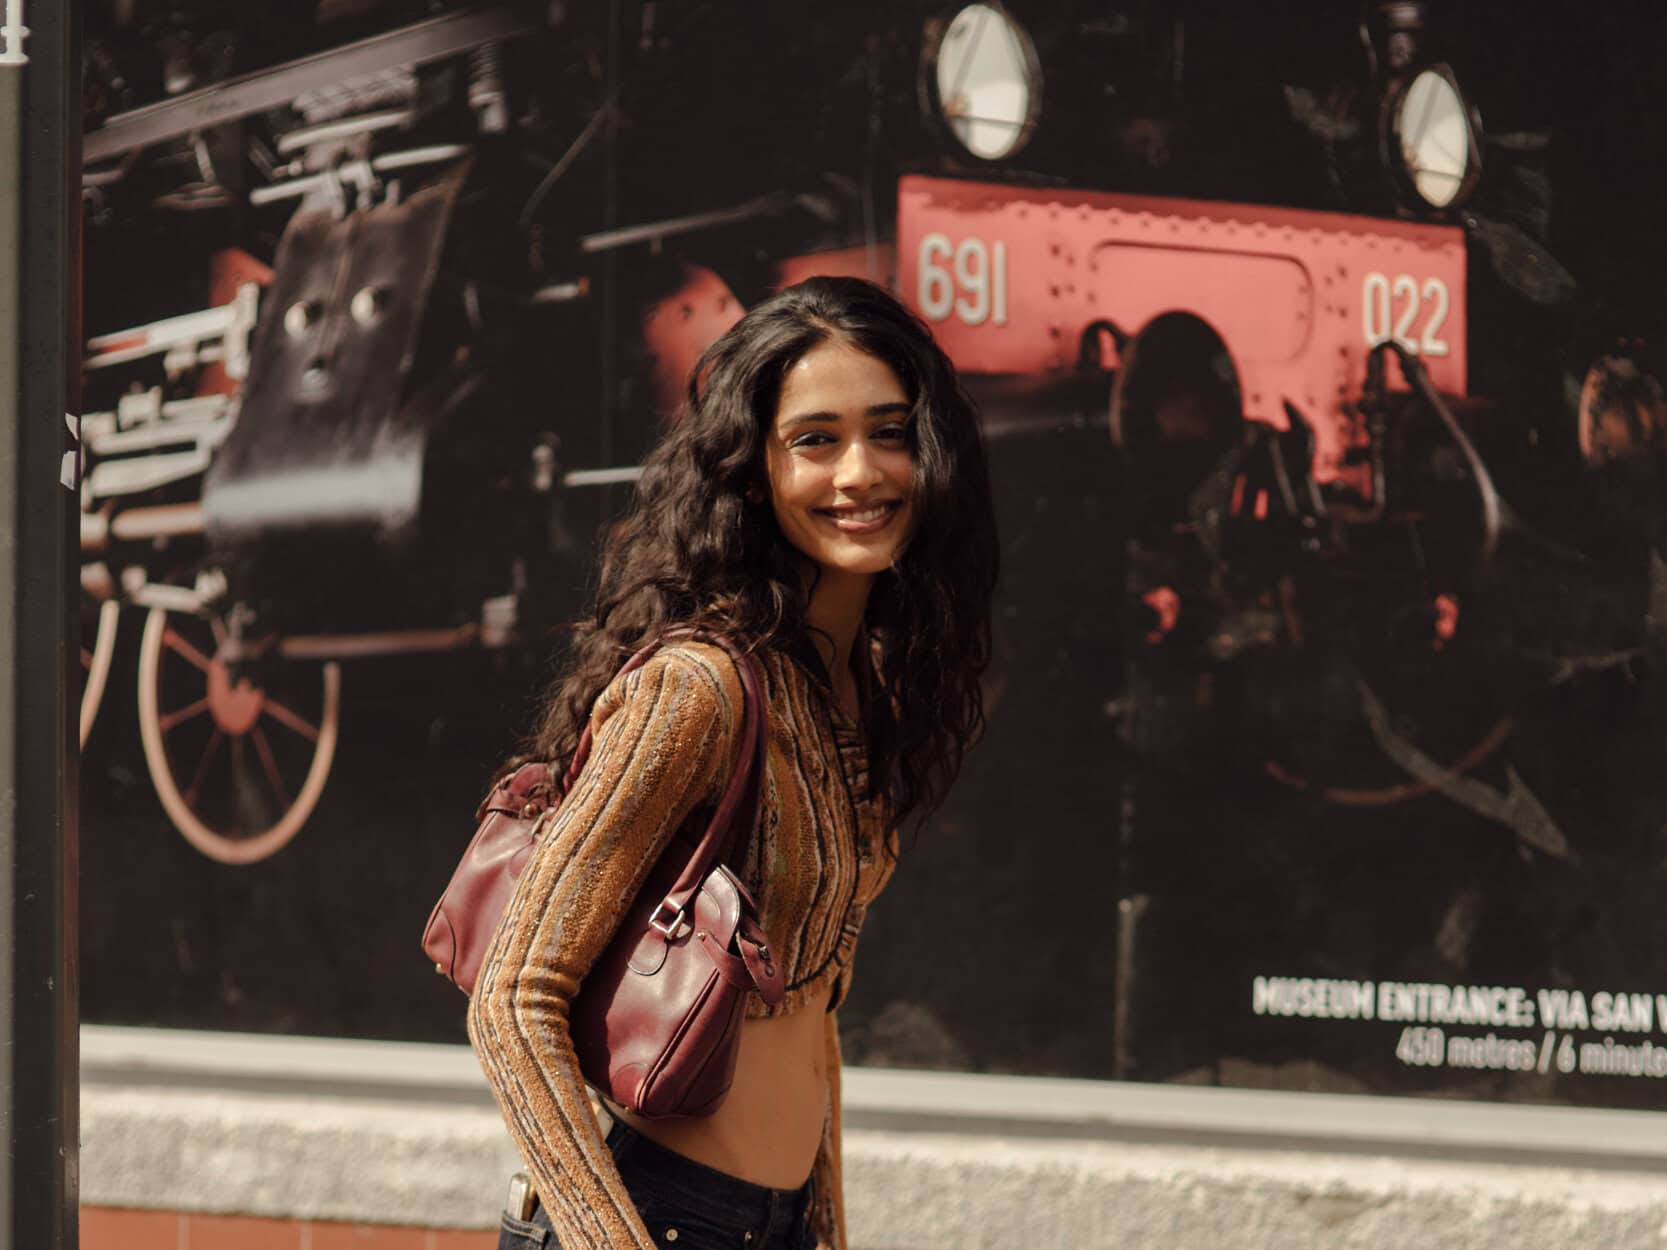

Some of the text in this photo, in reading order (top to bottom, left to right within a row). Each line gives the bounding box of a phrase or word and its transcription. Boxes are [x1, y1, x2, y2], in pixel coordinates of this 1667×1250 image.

[918, 234, 1449, 356] 691 022
[1253, 976, 1375, 1019] MUSEUM
[1377, 982, 1535, 1026] ENTRANCE:
[1537, 988, 1589, 1030] VIA
[1591, 991, 1653, 1032] SAN
[1396, 1027, 1445, 1066] 450
[1448, 1032, 1536, 1071] metres
[1537, 1030, 1556, 1074] /
[1556, 1034, 1576, 1073] 6
